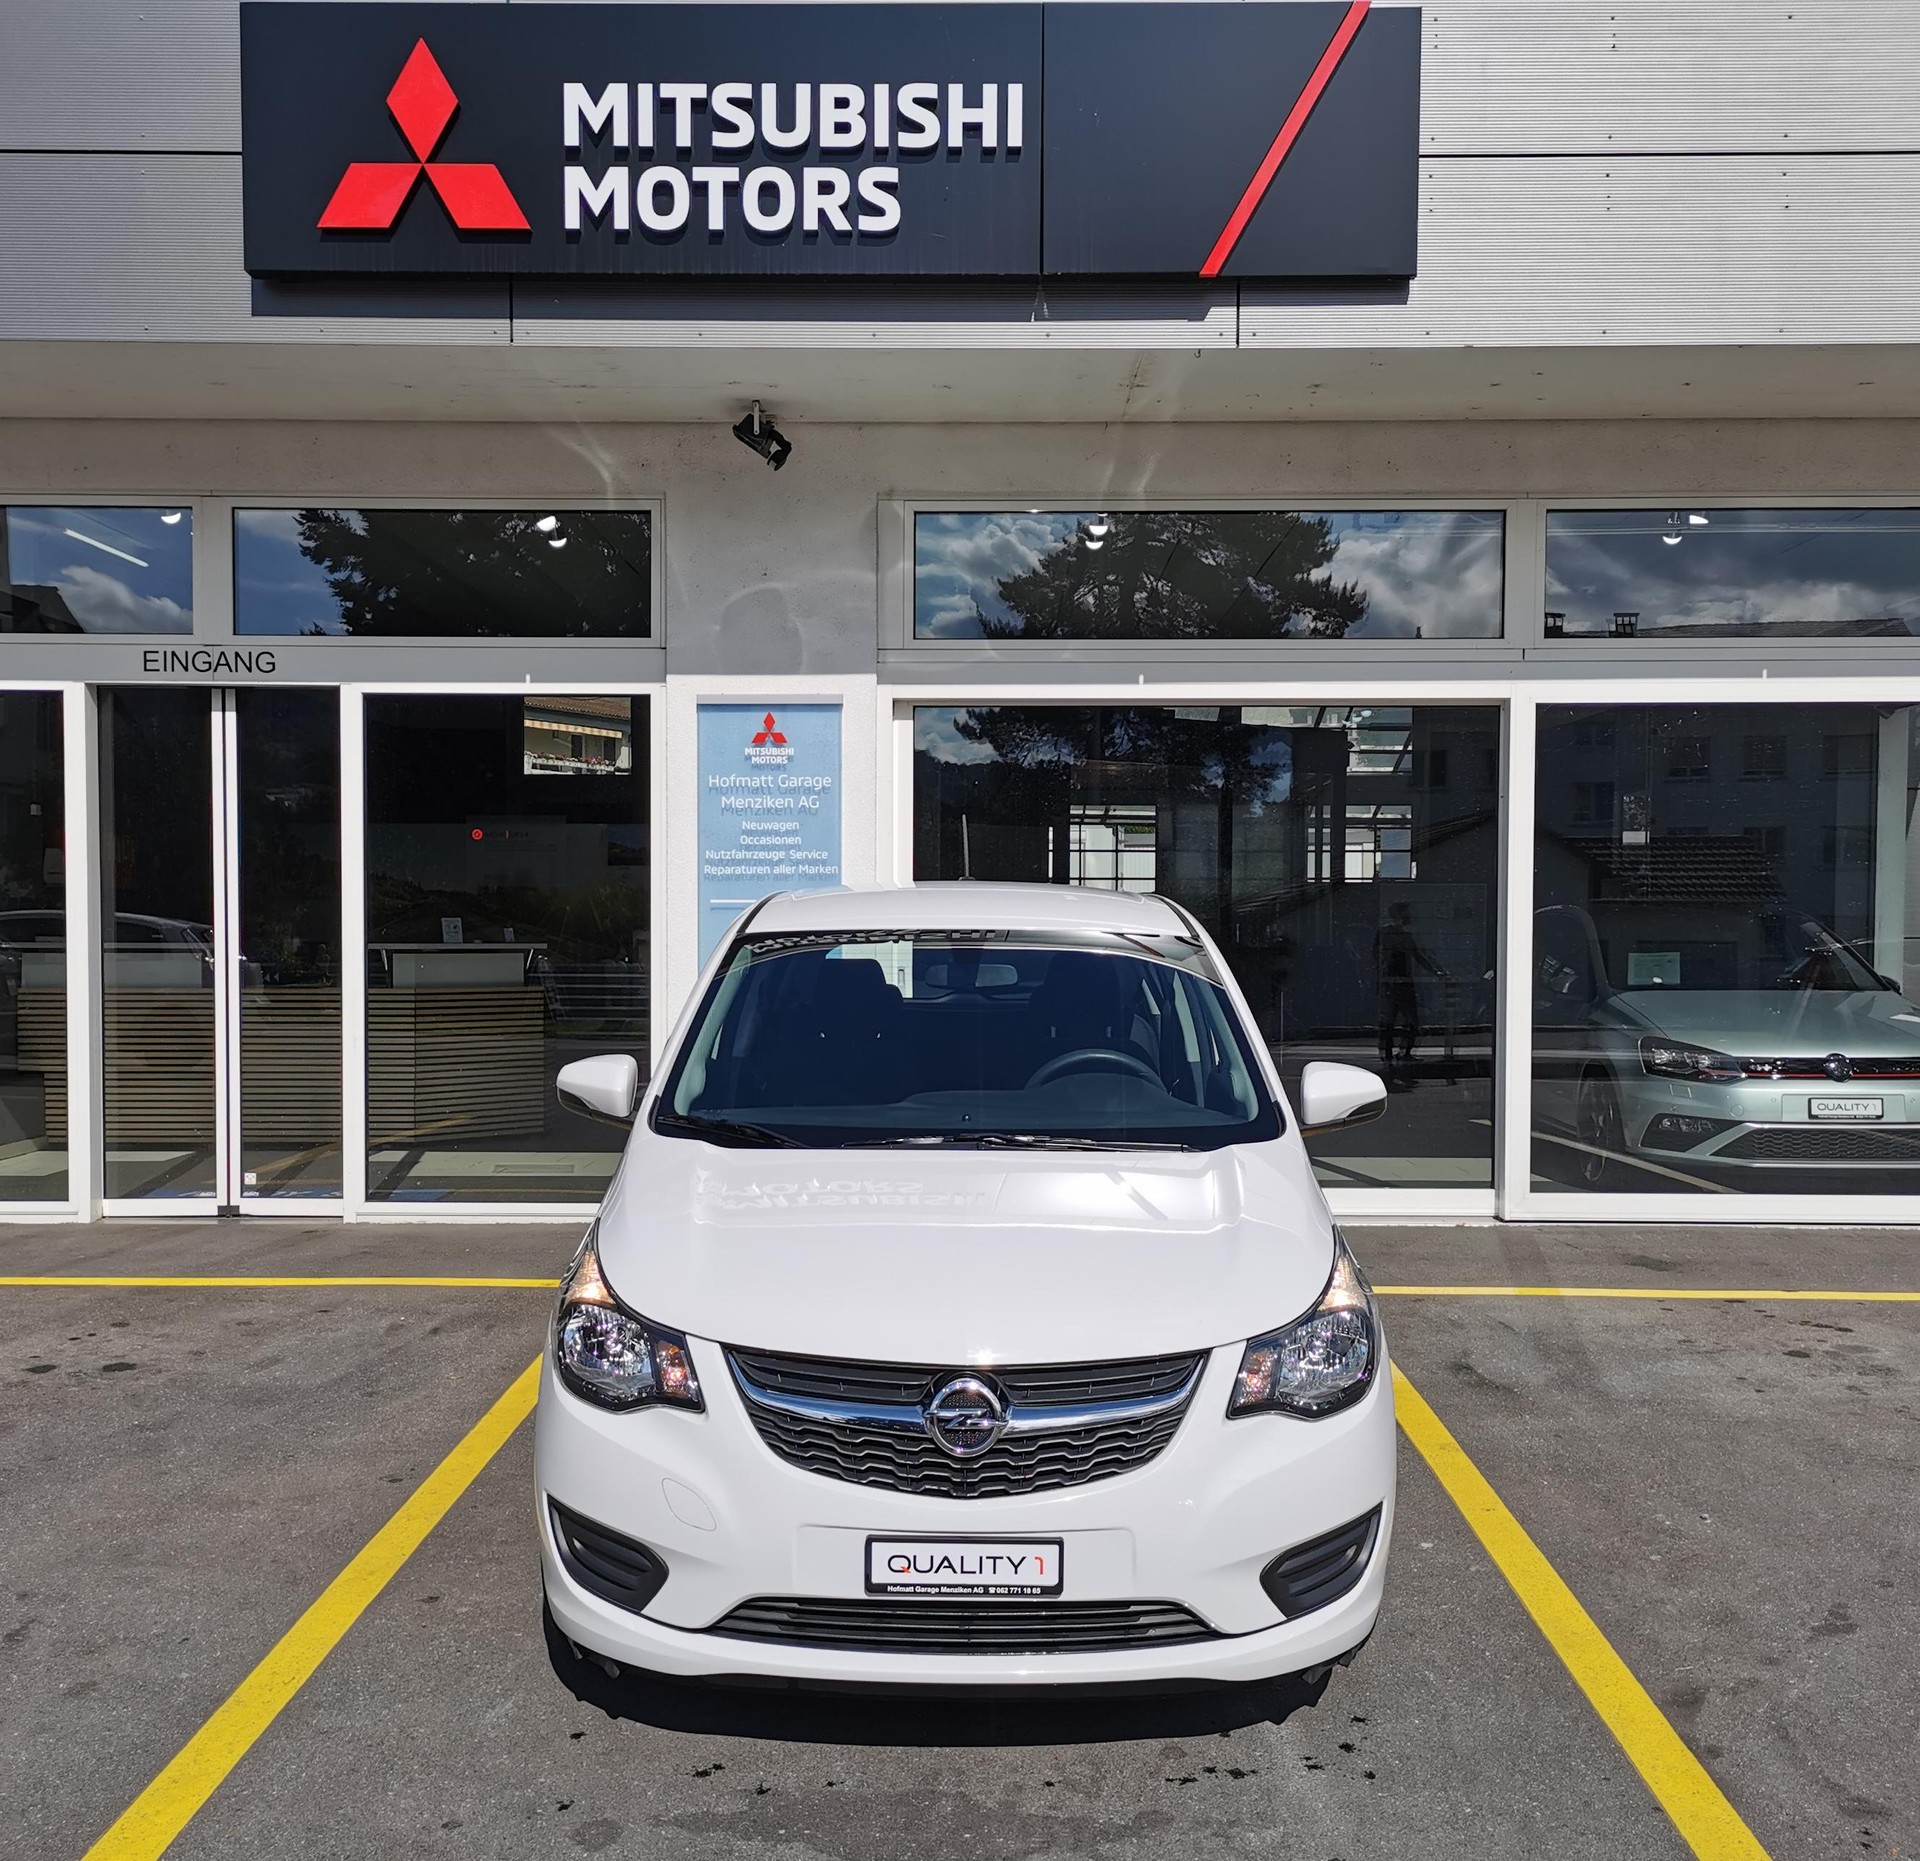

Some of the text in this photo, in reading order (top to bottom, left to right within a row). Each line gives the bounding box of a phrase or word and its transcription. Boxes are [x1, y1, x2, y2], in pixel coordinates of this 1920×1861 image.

[563, 82, 1024, 148] MITSUBISHI
[563, 165, 902, 232] MOTORS
[143, 650, 276, 674] EINGANG
[744, 747, 794, 756] MITSUBISHI
[751, 756, 789, 764] MOTORS
[708, 774, 832, 791] Hofmatt Garage
[721, 795, 820, 809] Menziken AG
[742, 821, 800, 832] Neuwagen
[740, 835, 802, 845] Occasionen
[705, 849, 829, 861] Nutzfahrzeuge Service
[704, 865, 839, 875] Reparaturen aller Marken
[887, 1554, 1044, 1575] QUALITY 1
[887, 1585, 914, 1594] Hofmatt
[915, 1586, 940, 1595] Garage
[940, 1586, 972, 1594] Menziken
[972, 1586, 984, 1594] AG
[1010, 1587, 1021, 1595] 771
